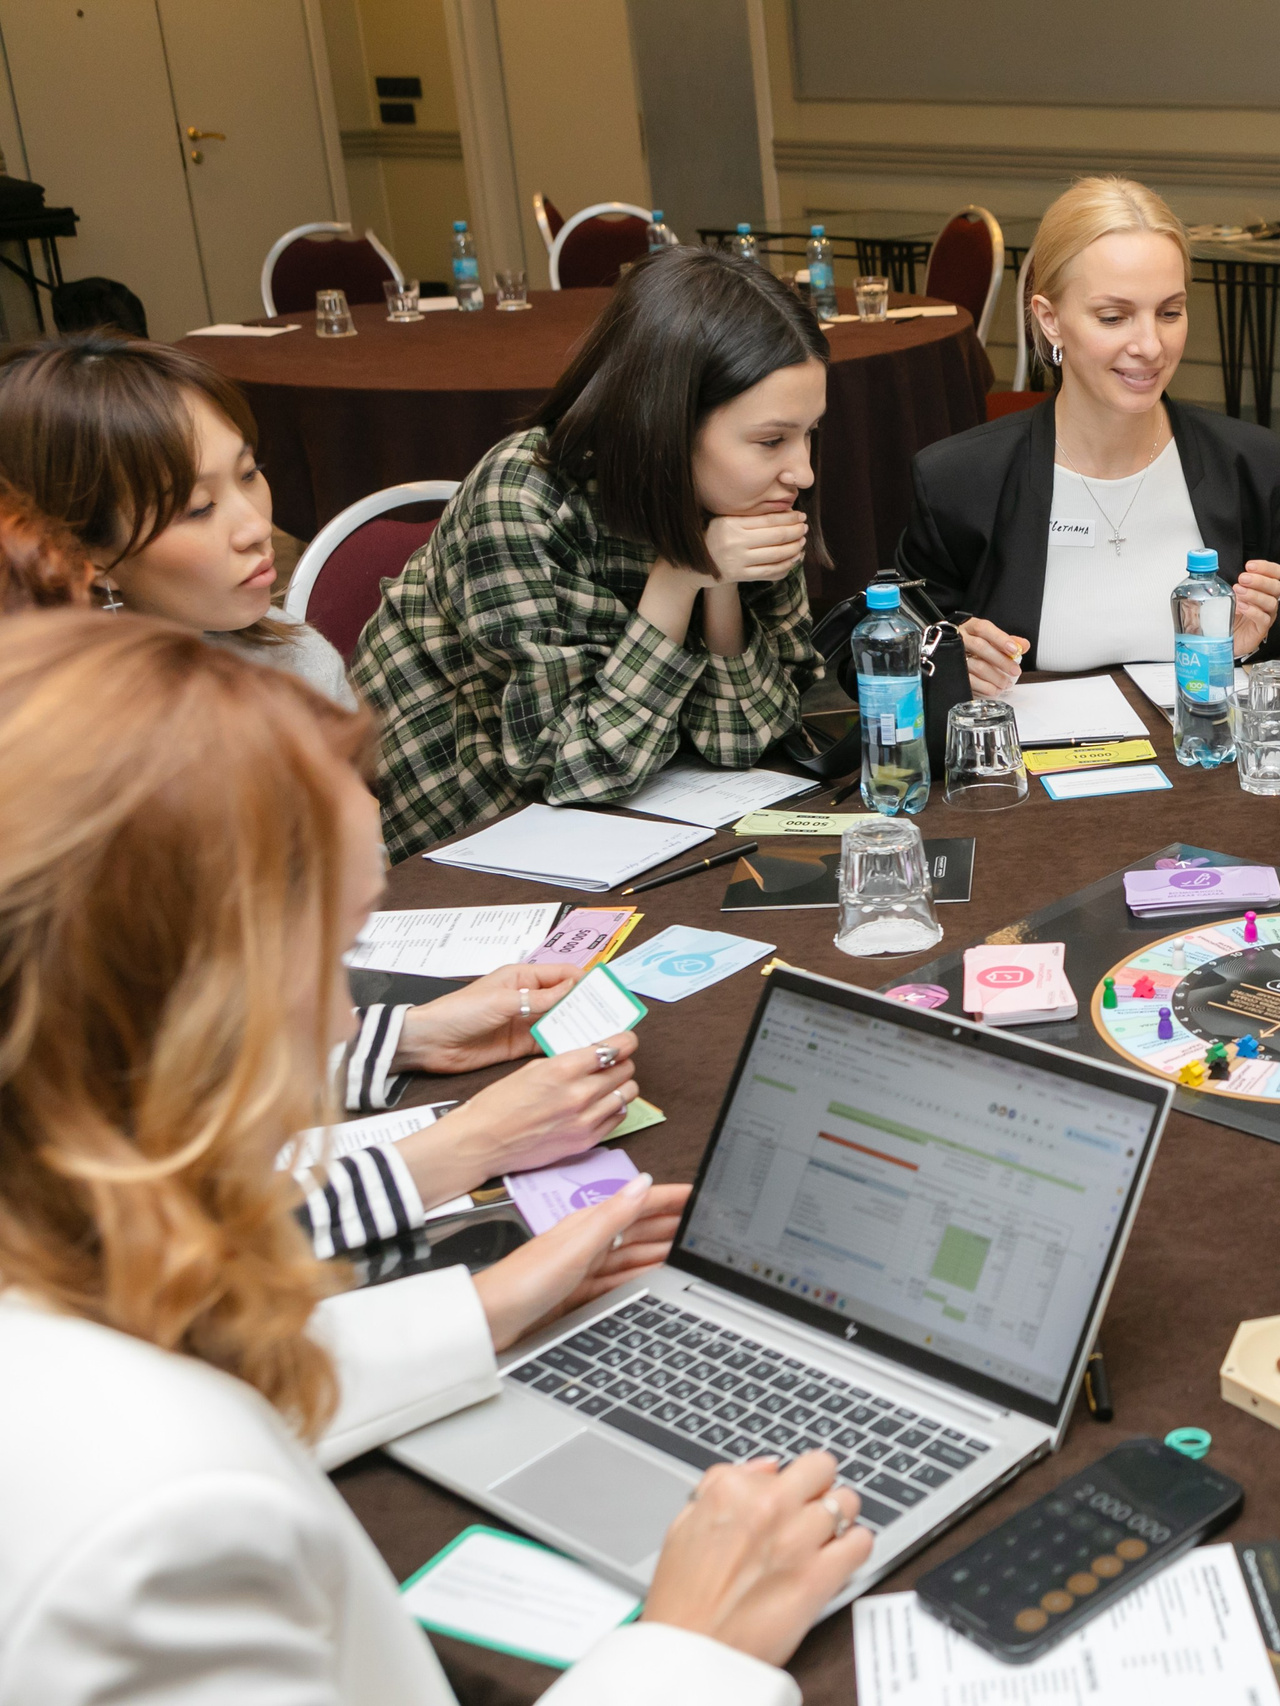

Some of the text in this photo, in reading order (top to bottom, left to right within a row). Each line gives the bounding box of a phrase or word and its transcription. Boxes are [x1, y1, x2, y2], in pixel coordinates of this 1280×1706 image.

[1175, 651, 1200, 667] КВА
[571, 929, 591, 941] 500
[559, 941, 579, 953] 000
[1074, 1484, 1171, 1544] 2 000 000
